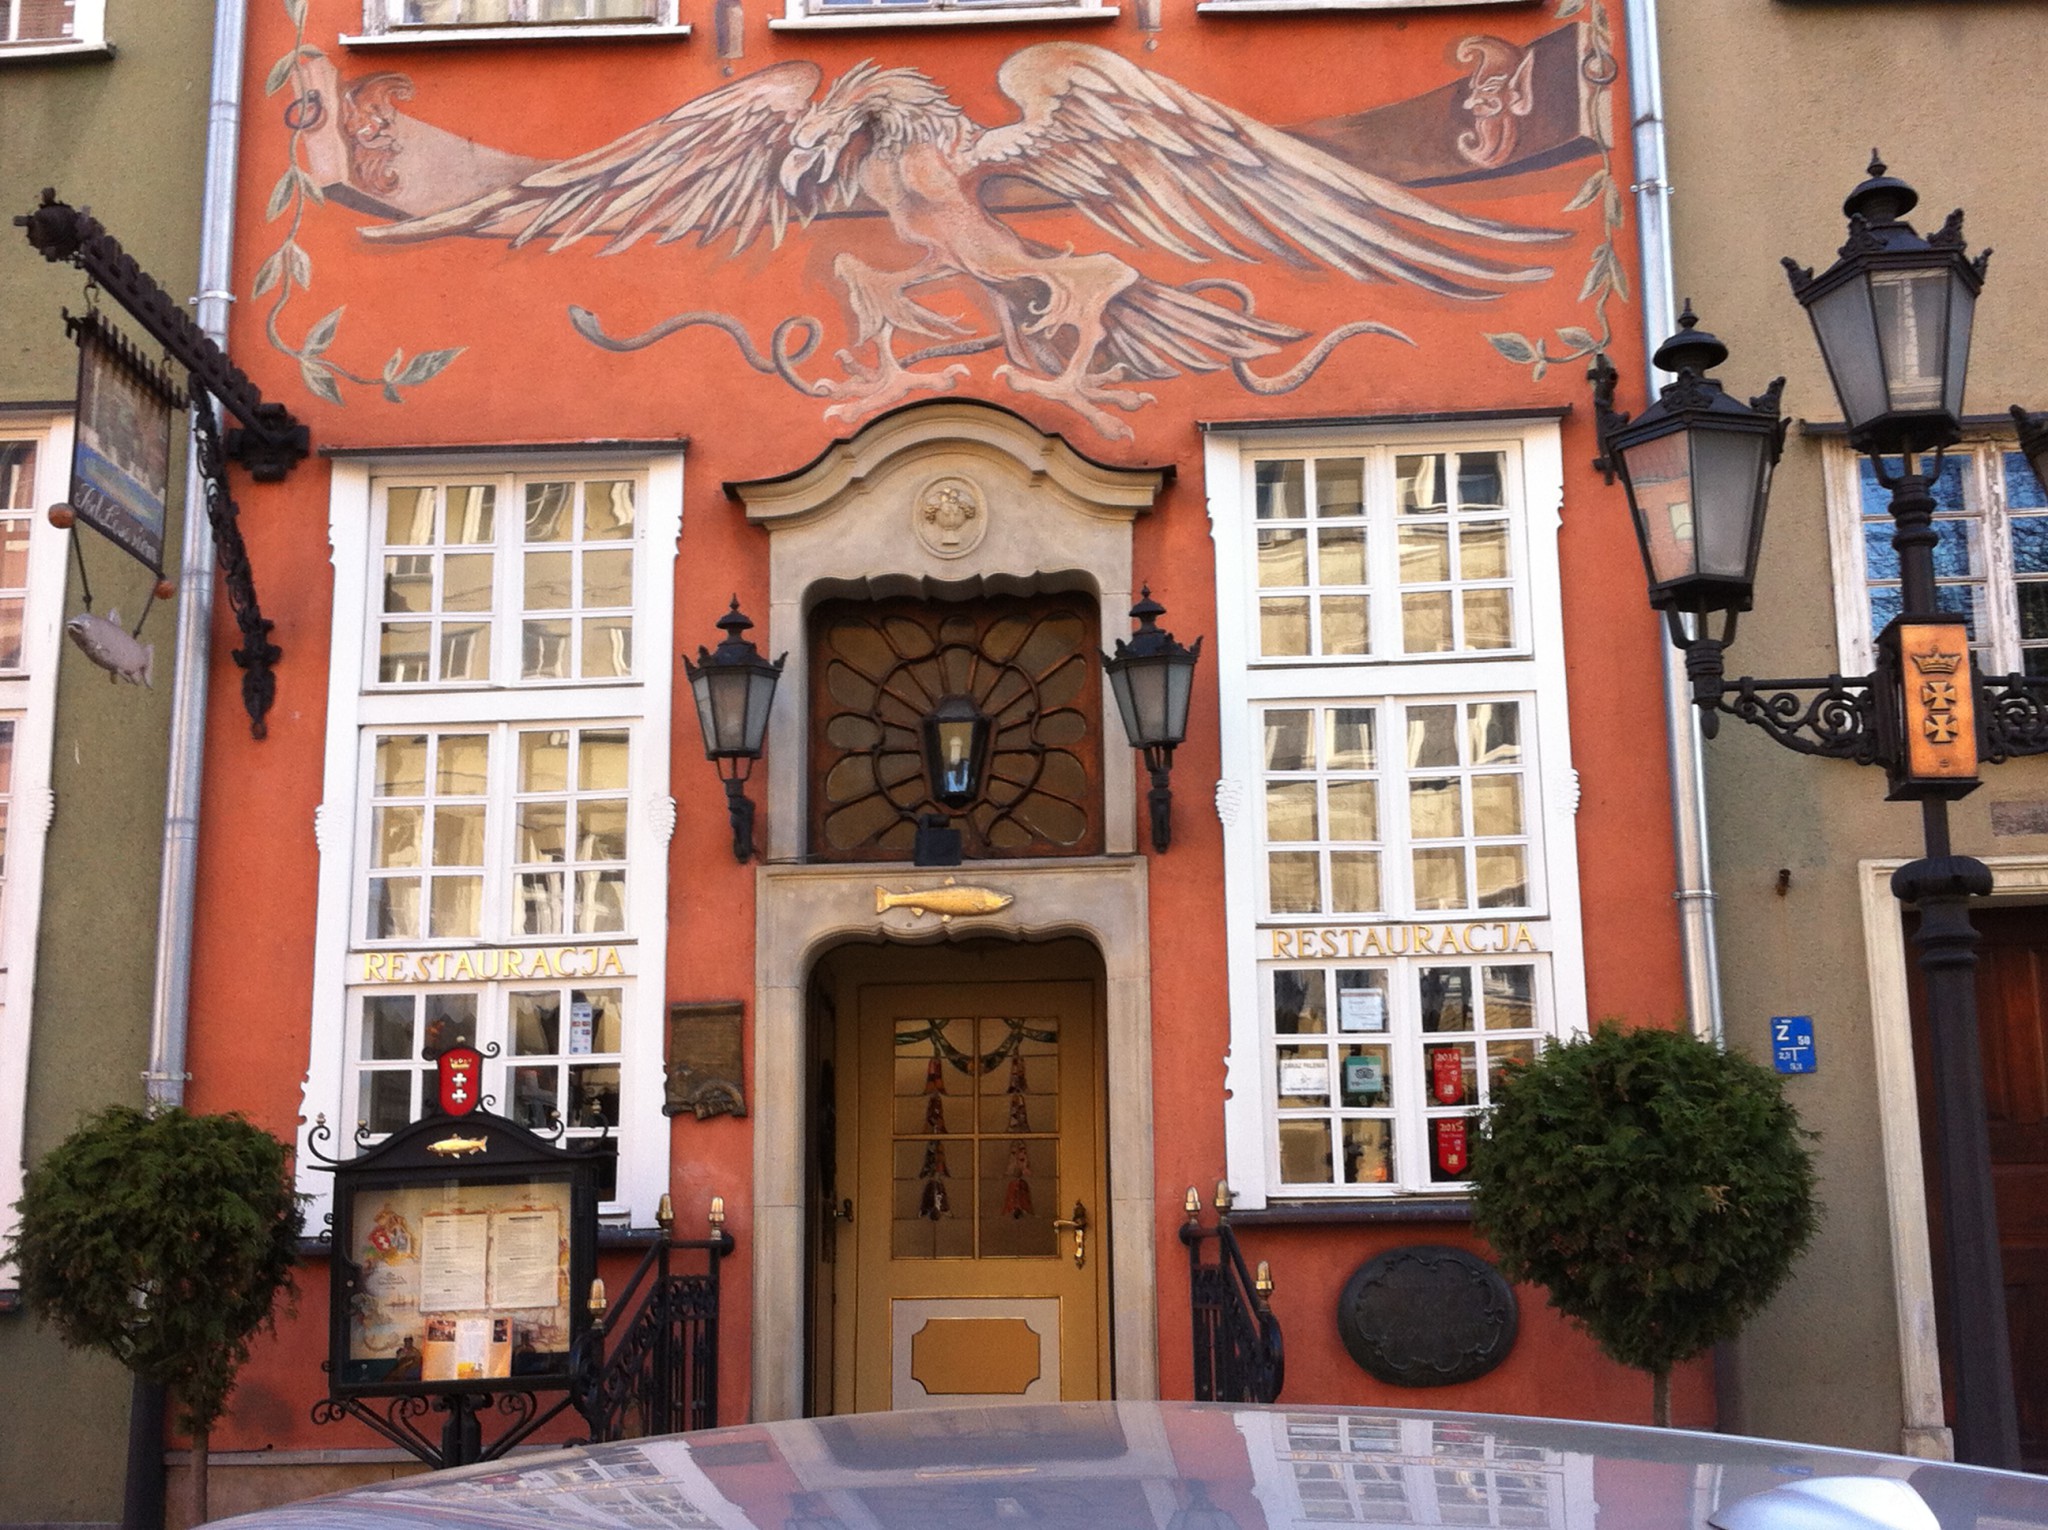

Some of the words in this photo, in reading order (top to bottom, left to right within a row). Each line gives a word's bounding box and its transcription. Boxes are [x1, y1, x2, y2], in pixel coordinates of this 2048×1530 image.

[1272, 923, 1538, 958] RESTAURACJA
[363, 946, 625, 981] RESTAURACJA
[1776, 1025, 1790, 1041] Z
[1439, 1120, 1465, 1132] 2015
